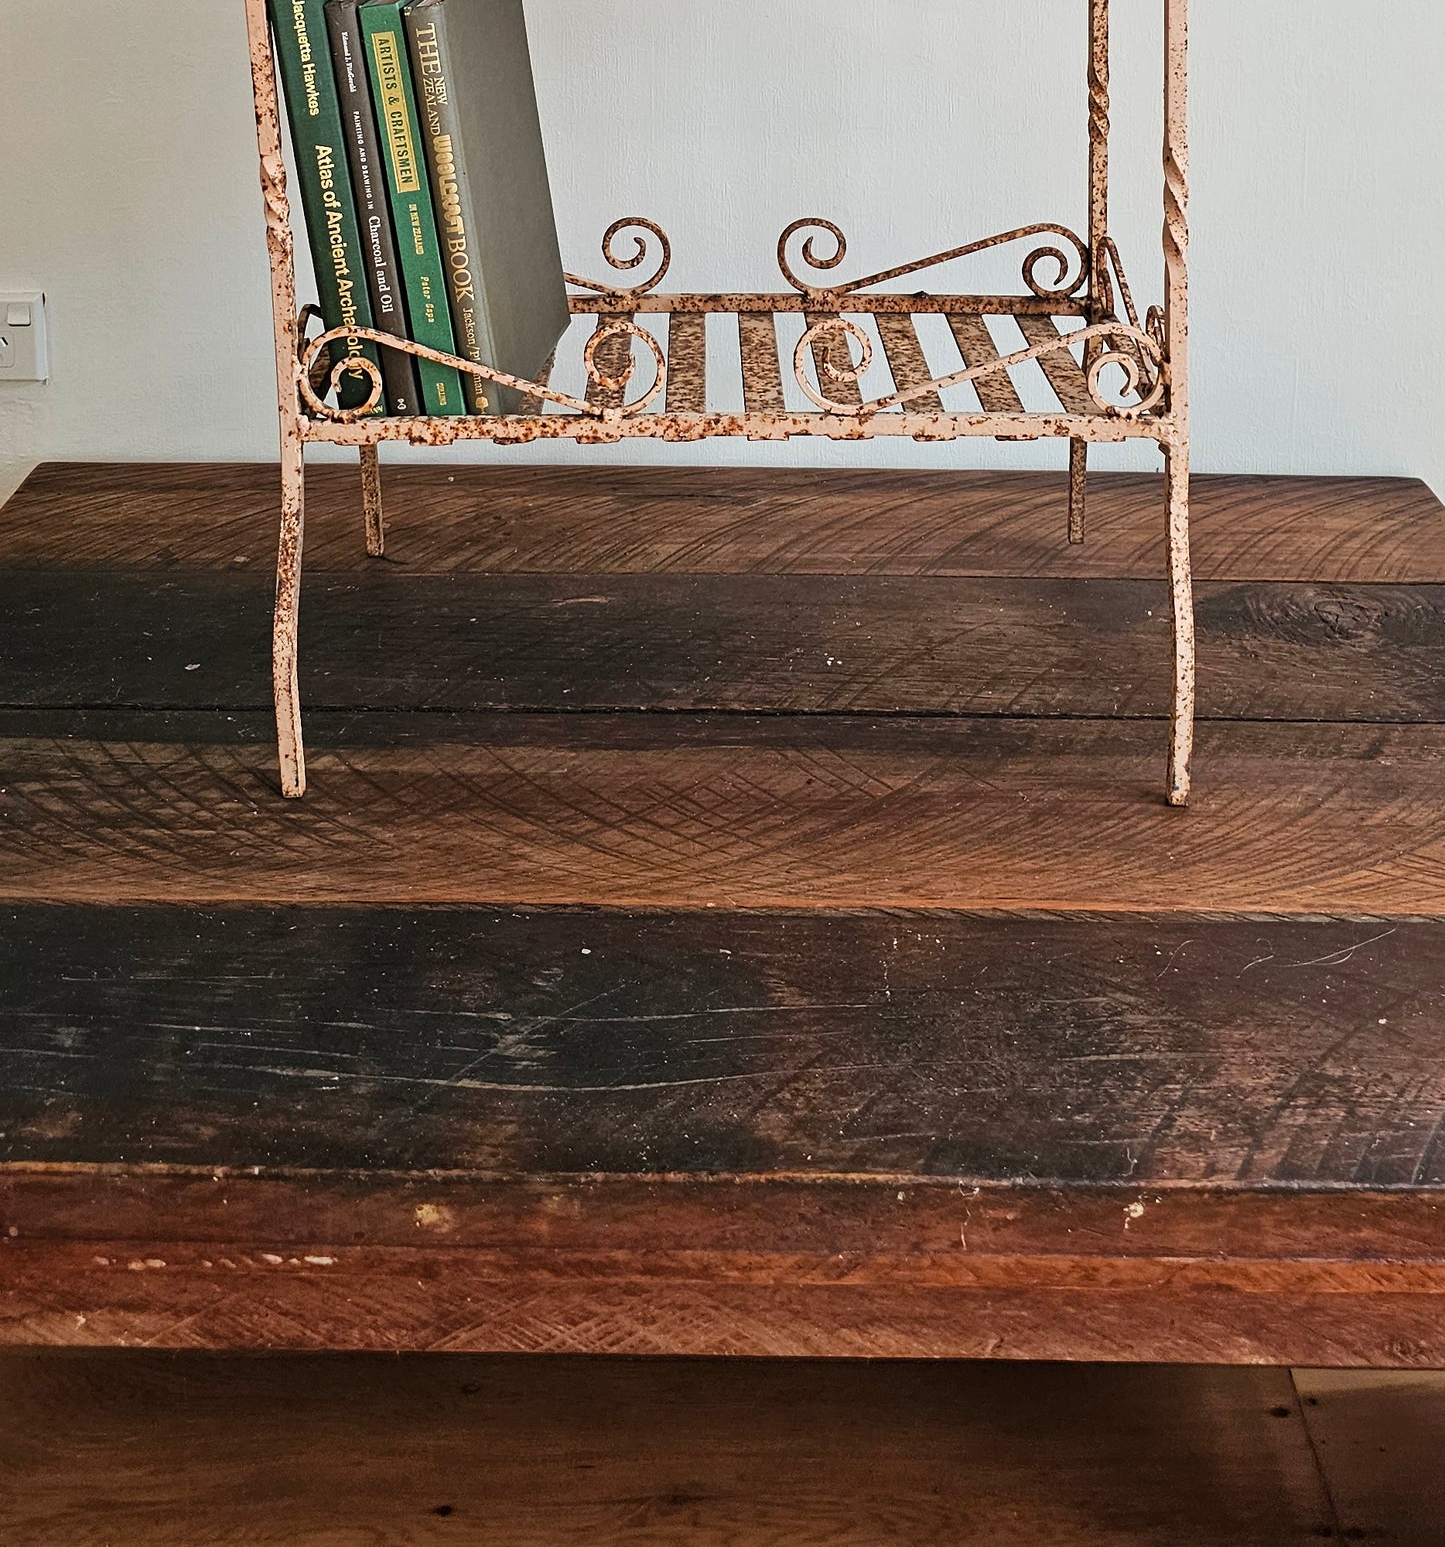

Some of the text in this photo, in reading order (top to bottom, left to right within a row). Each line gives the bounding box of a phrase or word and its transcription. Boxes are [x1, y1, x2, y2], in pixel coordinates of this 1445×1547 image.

[302, 63, 320, 116] Hawkes
[416, 22, 441, 75] THE
[434, 76, 448, 104] NEW
[378, 38, 413, 184] ARTISTS & CRAFTSMEN
[423, 77, 440, 135] ZEALAND
[353, 110, 374, 210] PAINTING AND DRAWING IN
[315, 144, 364, 380] Atlas of Ancient Archaoloy
[368, 214, 393, 313] Charcoal and Oil
[432, 134, 474, 302] WOOLCRAFT BOOK
[462, 307, 483, 395] Jackson/Plman
